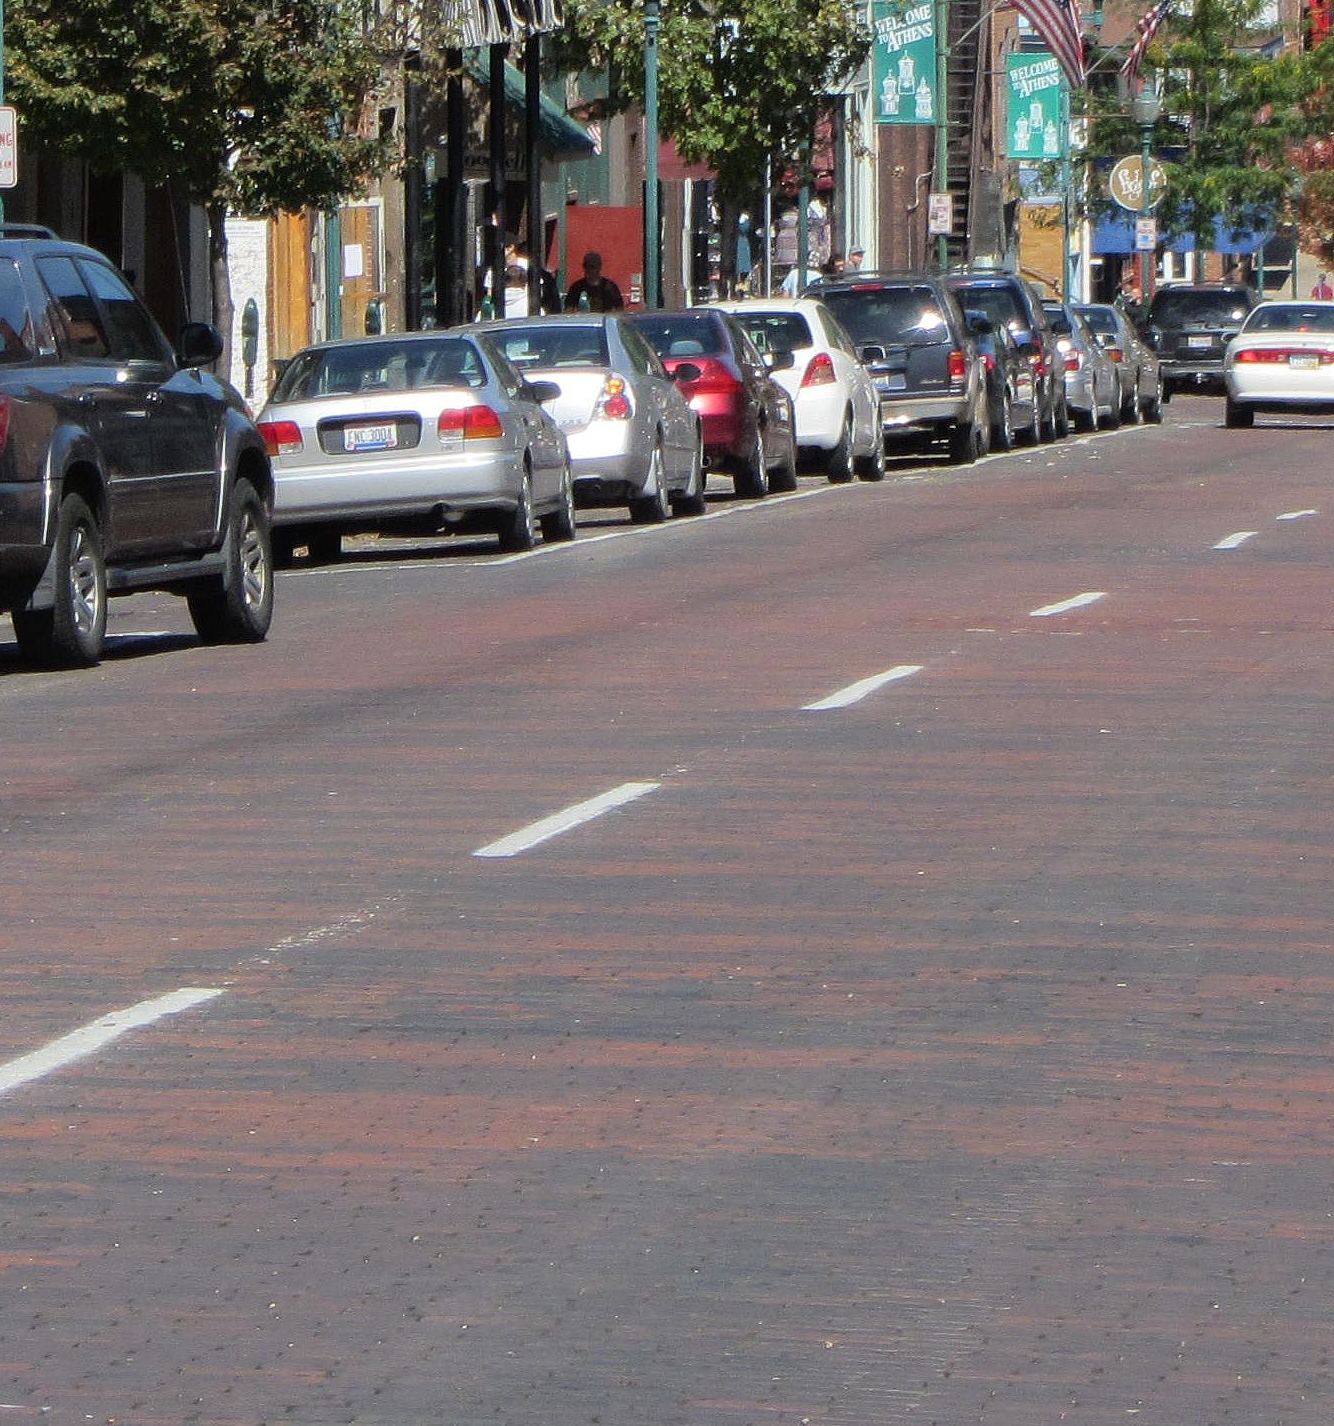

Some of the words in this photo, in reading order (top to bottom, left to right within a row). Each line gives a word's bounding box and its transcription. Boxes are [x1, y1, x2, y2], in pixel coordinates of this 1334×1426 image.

[887, 22, 933, 53] ATHENS
[1010, 58, 1059, 82] WELCOME
[1019, 73, 1060, 99] ATHENS
